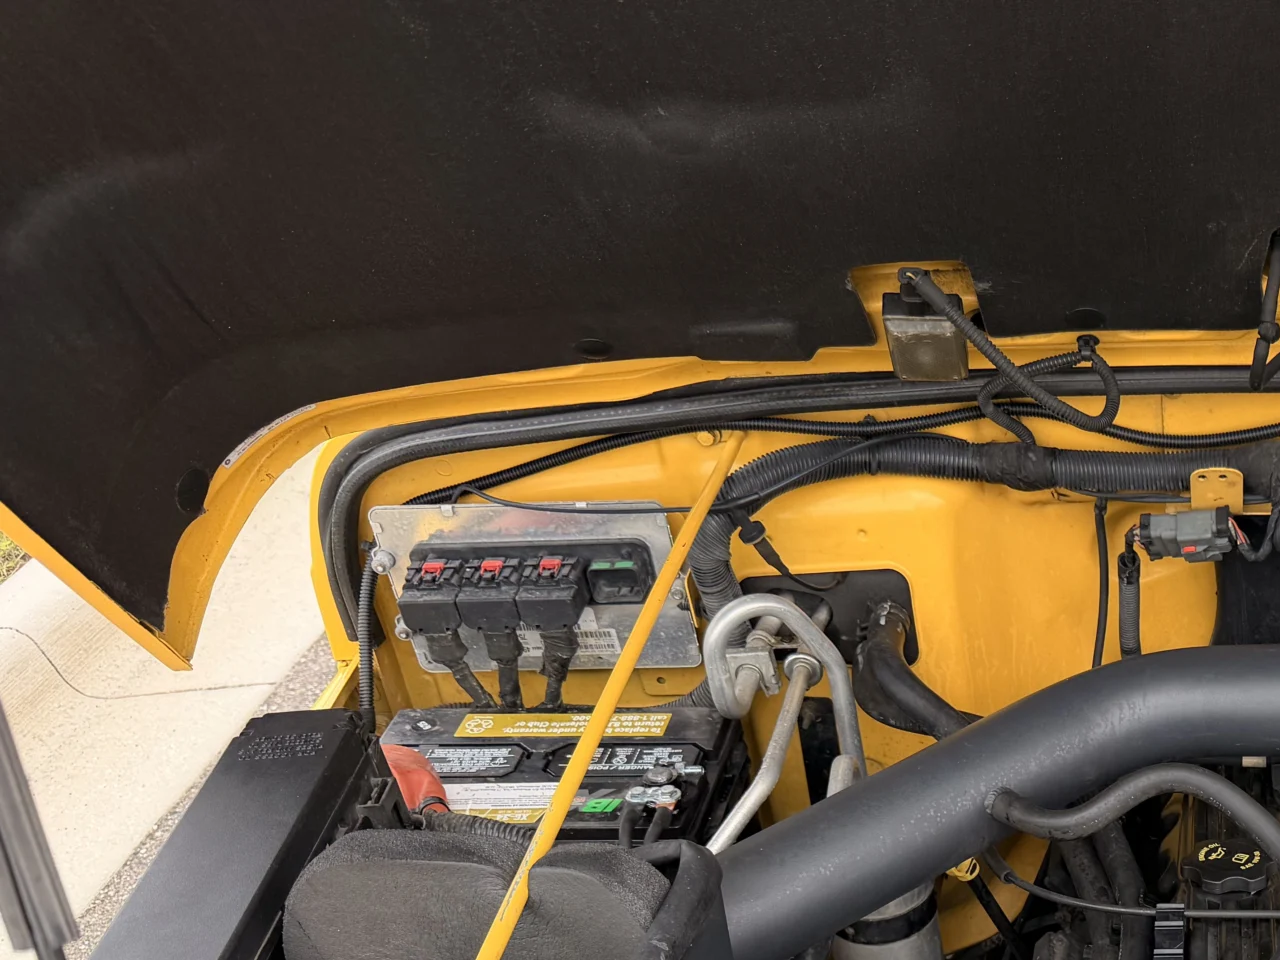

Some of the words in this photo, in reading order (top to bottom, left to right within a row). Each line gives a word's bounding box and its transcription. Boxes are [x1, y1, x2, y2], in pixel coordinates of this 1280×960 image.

[527, 720, 550, 728] Club
[622, 720, 633, 728] to
[615, 726, 650, 734] replace
